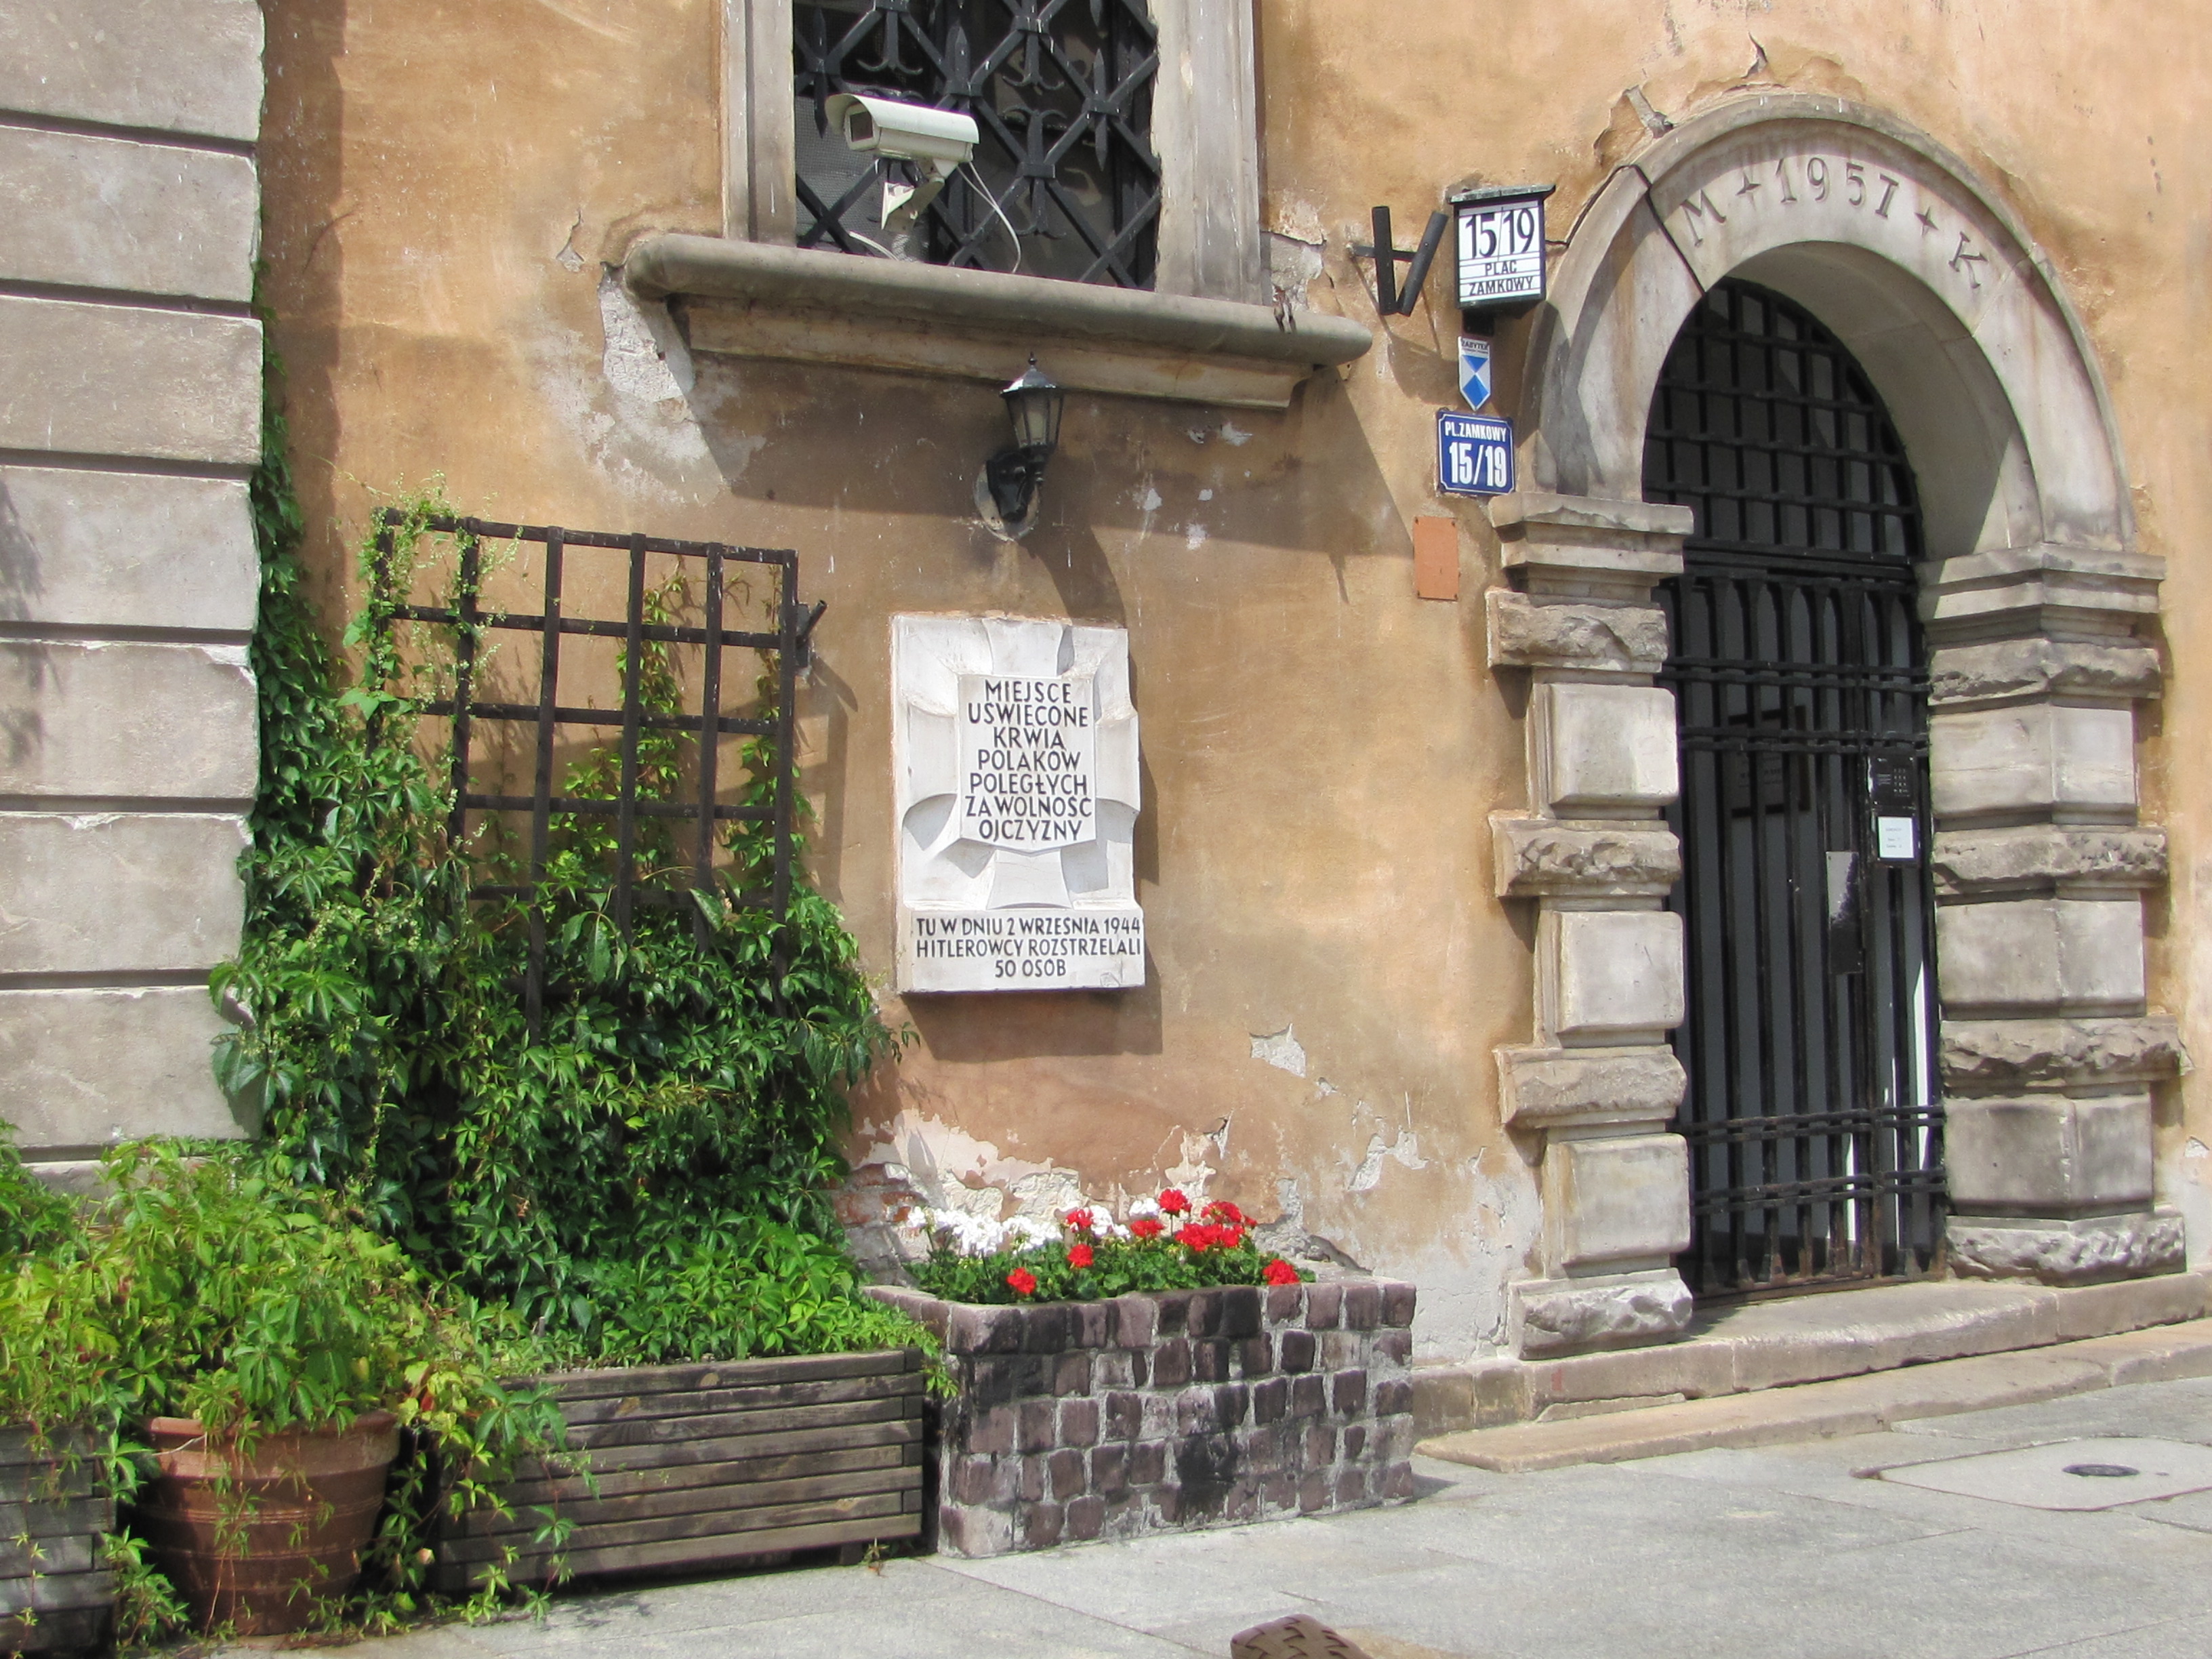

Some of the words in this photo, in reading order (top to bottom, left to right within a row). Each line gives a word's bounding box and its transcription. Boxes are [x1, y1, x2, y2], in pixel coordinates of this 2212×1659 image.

[1680, 189, 1727, 247] M
[1775, 157, 1899, 220] 1957
[1948, 231, 1989, 289] K
[1485, 260, 1517, 276] PLAC
[1469, 276, 1534, 296] ZAMKOWY
[1449, 442, 1507, 488] 15/19
[985, 679, 1071, 703] MIEJSCE
[970, 773, 1087, 796] POLEGŁYCH
[965, 796, 991, 817] ZA
[979, 819, 1082, 842] OJCZYZNY
[916, 918, 936, 937] TU
[940, 918, 958, 935] W
[962, 917, 1002, 936] DNIU
[1006, 917, 1015, 936] 2
[1103, 917, 1141, 935] 1944
[916, 939, 1023, 958] HITLEROWCY
[1029, 938, 1141, 956] ROZSTRZELALI
[995, 959, 1017, 978] 50
